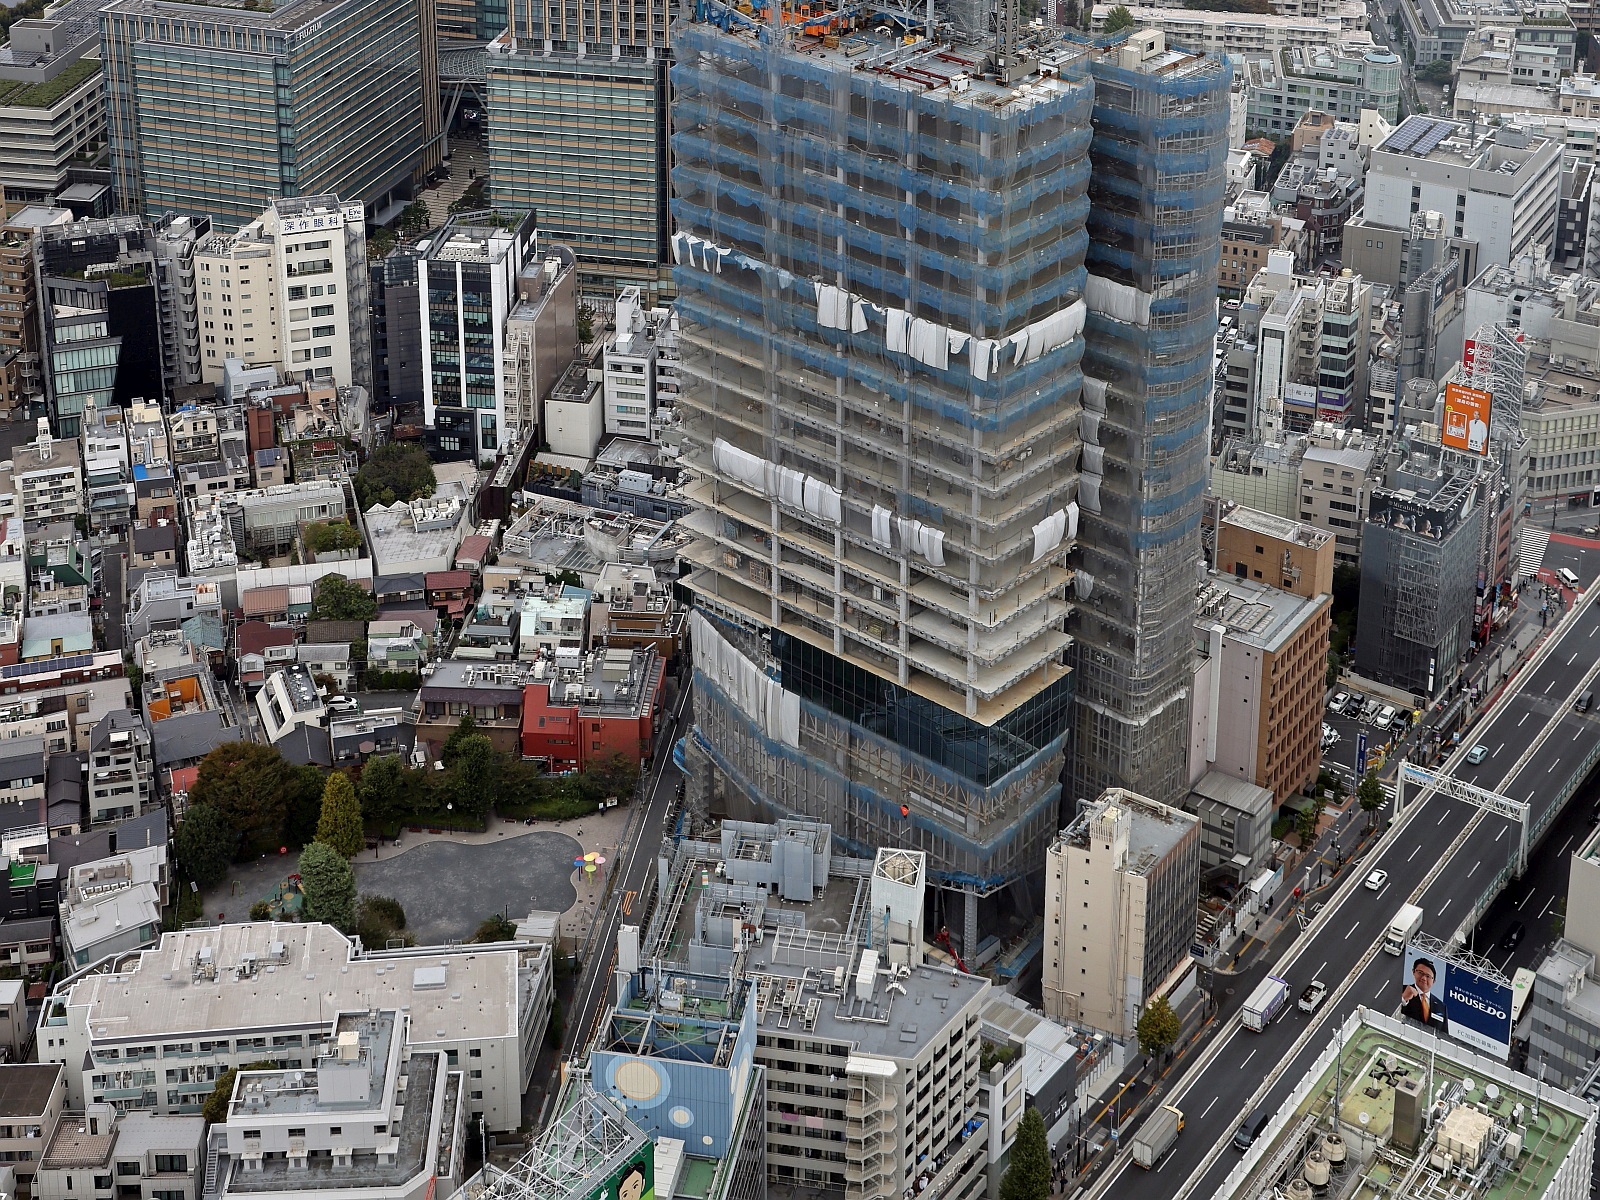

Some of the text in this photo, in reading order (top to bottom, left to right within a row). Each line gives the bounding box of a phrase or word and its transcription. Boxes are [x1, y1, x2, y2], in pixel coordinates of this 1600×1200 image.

[348, 208, 362, 216] Eye
[284, 216, 338, 231] 深作眼科
